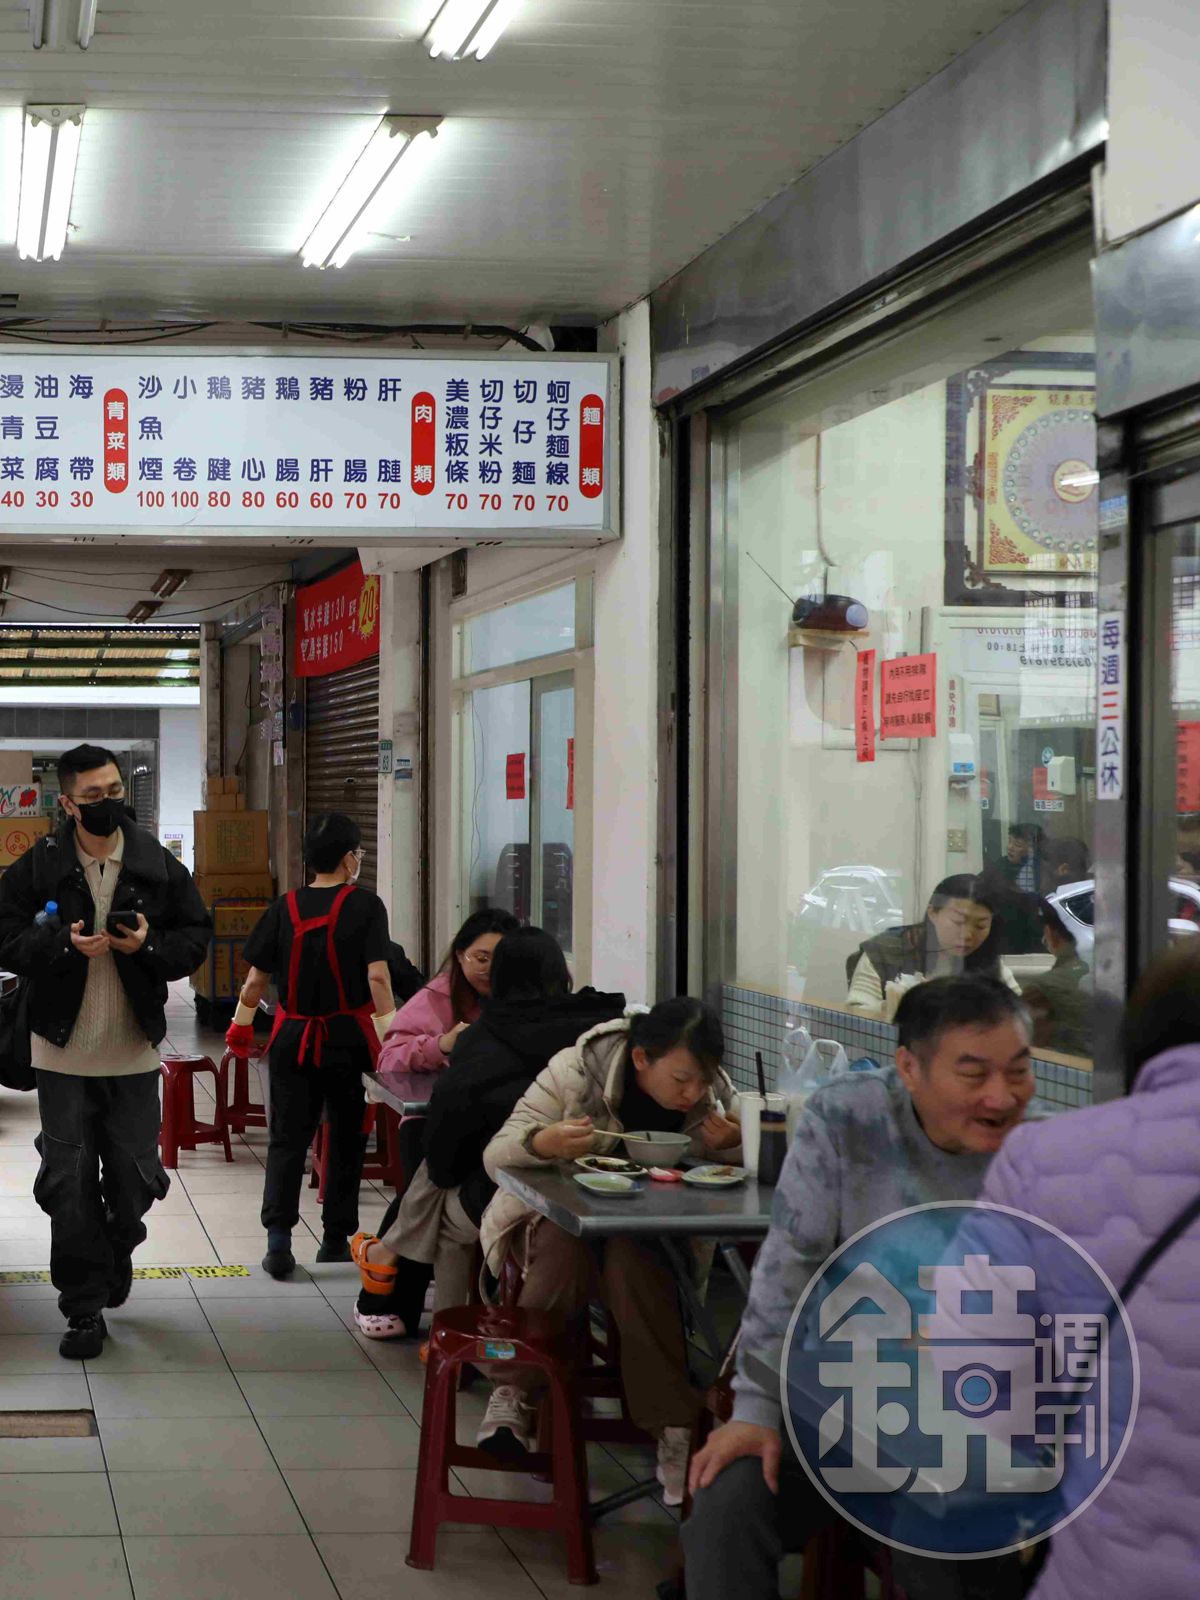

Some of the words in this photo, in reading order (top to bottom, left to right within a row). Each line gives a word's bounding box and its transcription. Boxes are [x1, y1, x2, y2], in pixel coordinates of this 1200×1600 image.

[0, 374, 25, 481] 燙青菜
[34, 375, 59, 481] 油豆腐
[107, 401, 126, 481] 青菜類
[138, 375, 163, 481] 沙魚煙
[445, 378, 469, 484] 美濃粄條
[479, 379, 504, 484] 切仔米粉
[512, 379, 537, 485] 切仔麵
[546, 380, 570, 485] 蚵仔麵線
[0, 491, 25, 507] 40
[35, 491, 59, 507] 30
[70, 491, 94, 507] 30
[137, 491, 165, 507] 100
[171, 491, 199, 507] 100
[207, 491, 231, 508] 80
[242, 491, 265, 508] 80
[275, 491, 299, 508] 60
[310, 492, 333, 508] 60
[344, 493, 367, 509] 70
[378, 493, 401, 509] 70
[445, 493, 468, 510] 70
[479, 494, 502, 511] 70
[512, 494, 536, 511] 70
[546, 495, 569, 512] 70
[1100, 620, 1120, 793] 每週三公休
